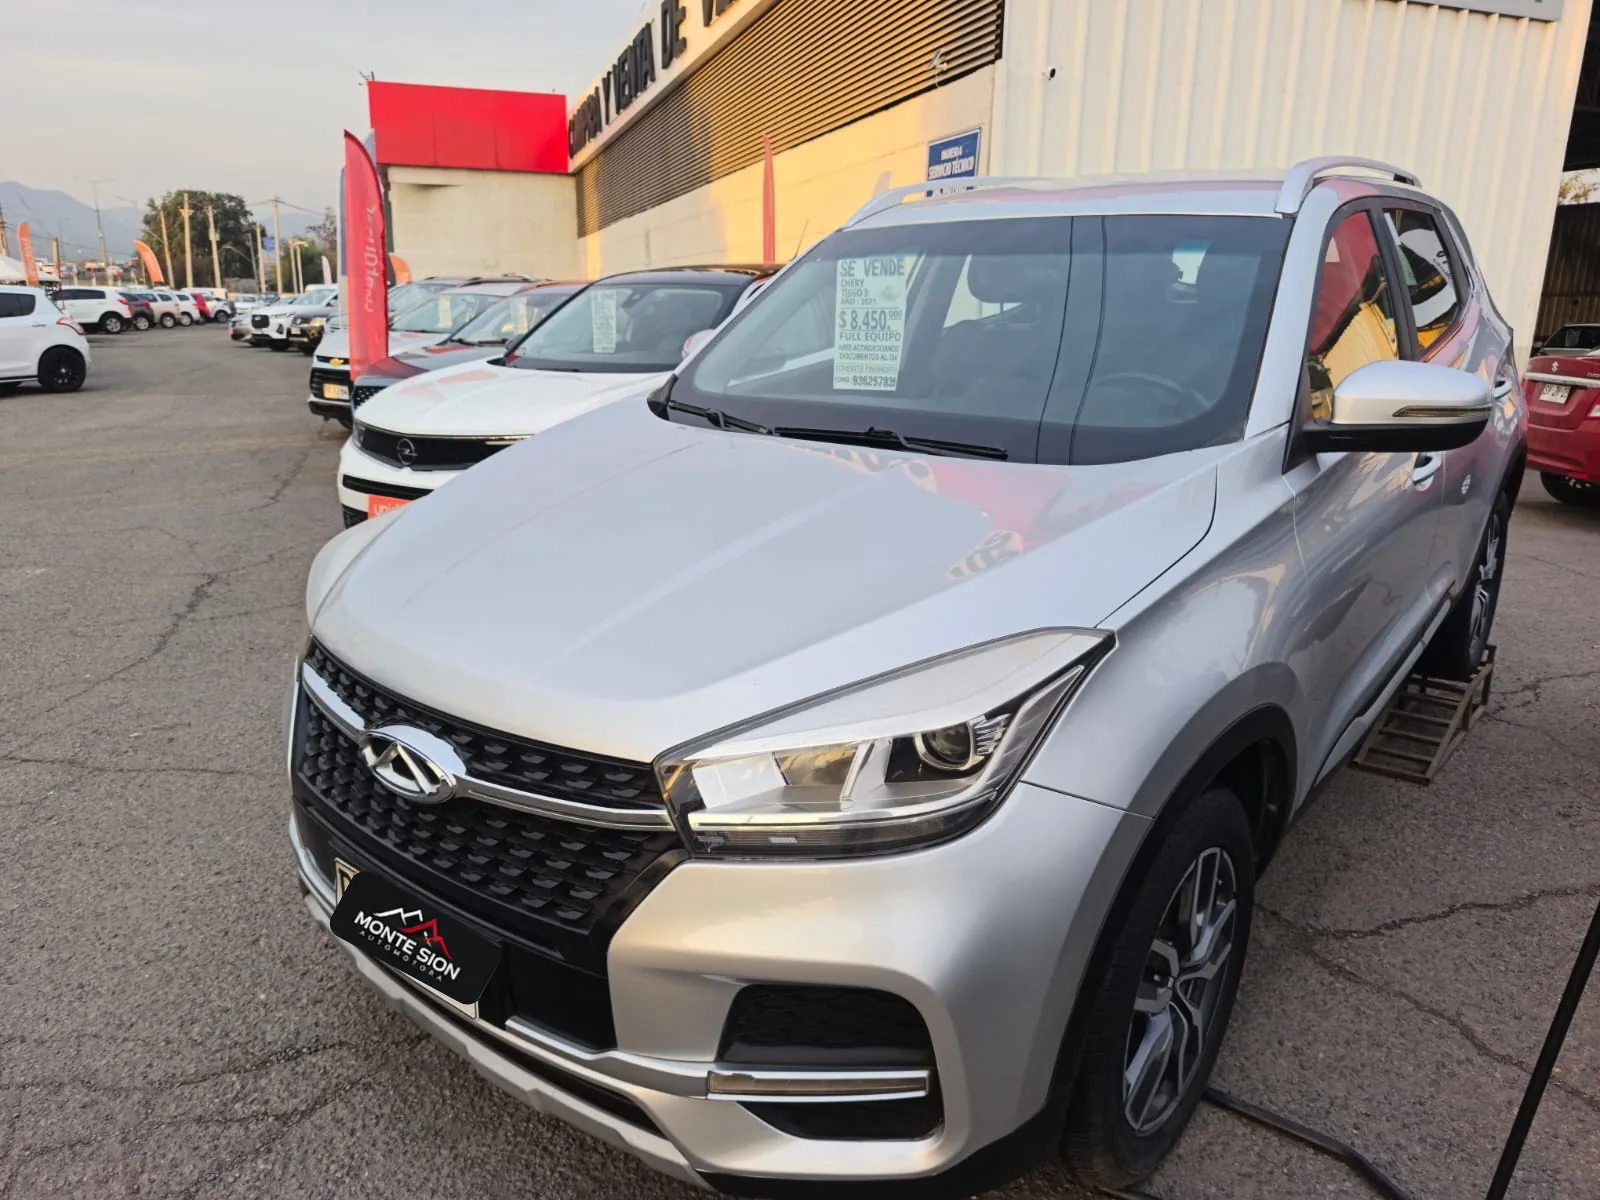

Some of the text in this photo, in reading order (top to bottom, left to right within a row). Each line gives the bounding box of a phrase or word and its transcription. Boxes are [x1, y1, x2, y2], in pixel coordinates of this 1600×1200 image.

[602, 71, 613, 126] Y
[612, 22, 656, 116] VENTA
[661, 0, 687, 70] DE
[840, 257, 905, 277] SE VENDE
[840, 278, 865, 289] CHERY
[840, 288, 863, 298] TIGGO
[838, 310, 847, 329] $
[839, 331, 901, 342] FULL EQUIPO
